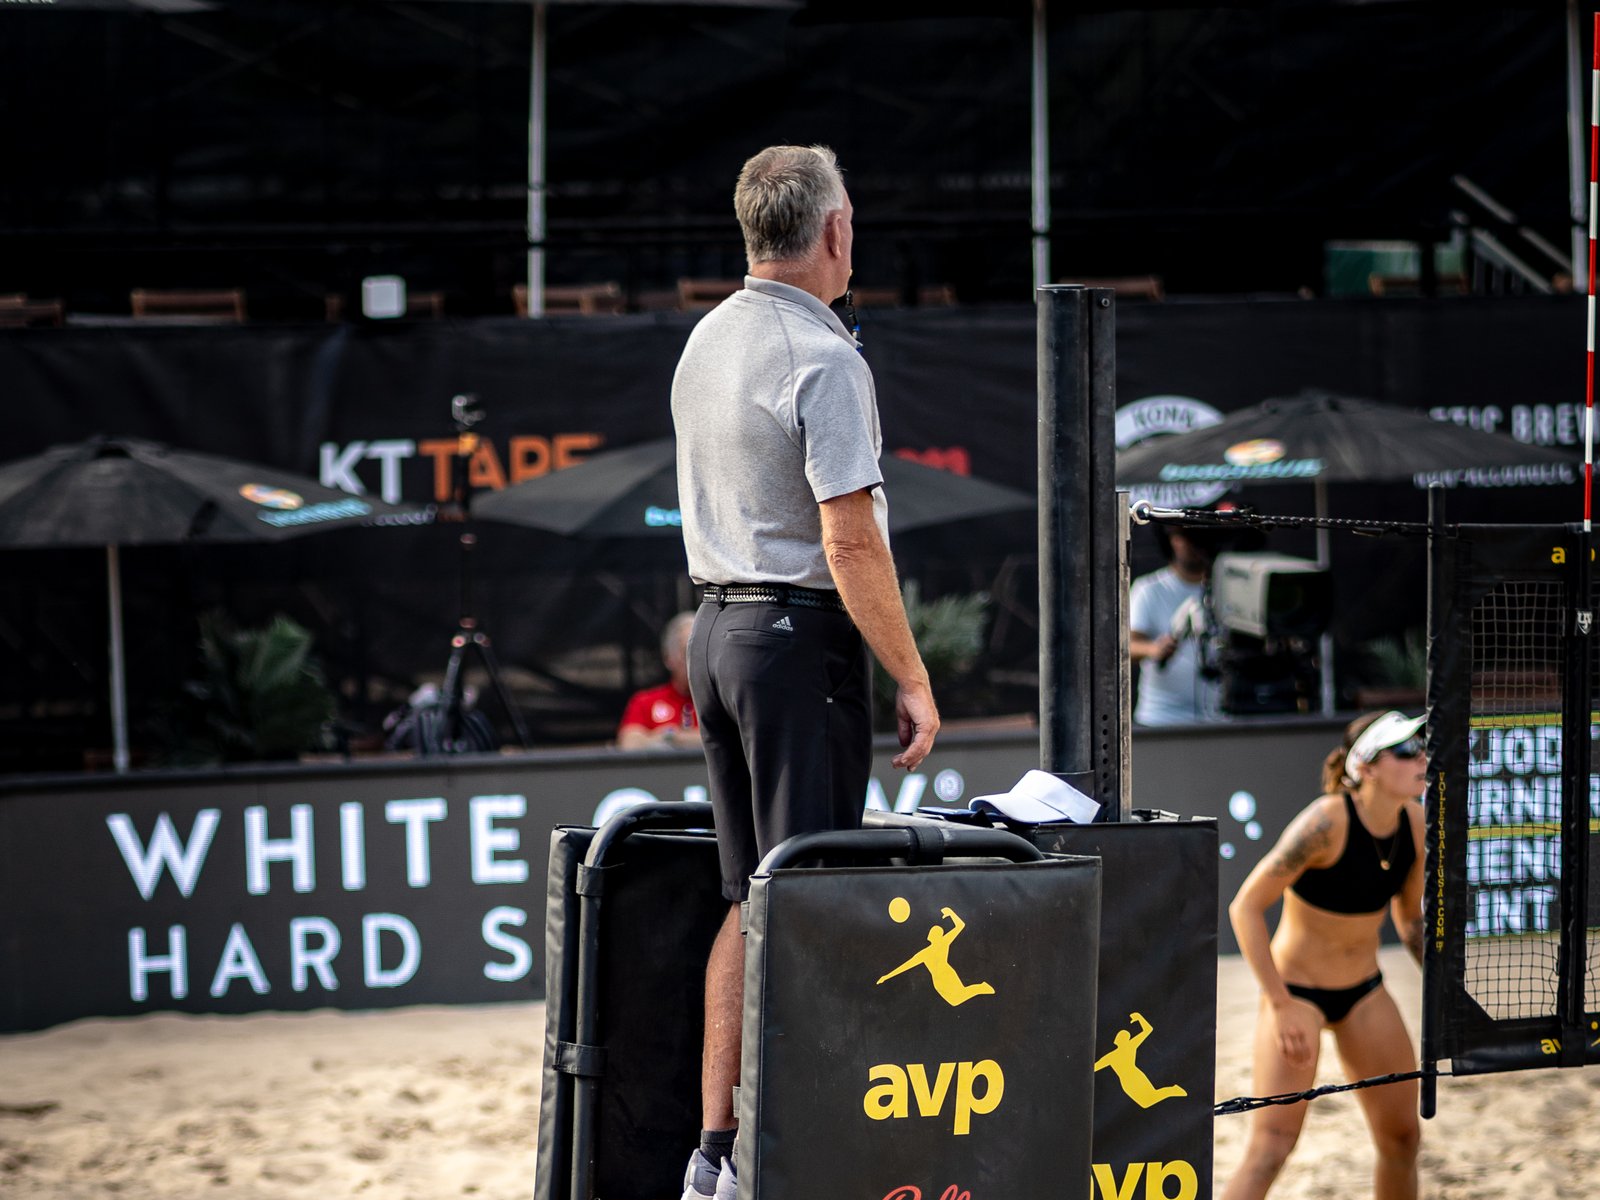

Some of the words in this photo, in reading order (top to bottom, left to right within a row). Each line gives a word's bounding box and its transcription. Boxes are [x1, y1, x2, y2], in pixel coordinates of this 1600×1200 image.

[319, 439, 415, 505] KT
[772, 623, 793, 632] adidas
[106, 794, 530, 901] WHITE
[127, 912, 424, 1002] HARD
[863, 1058, 1005, 1135] avp
